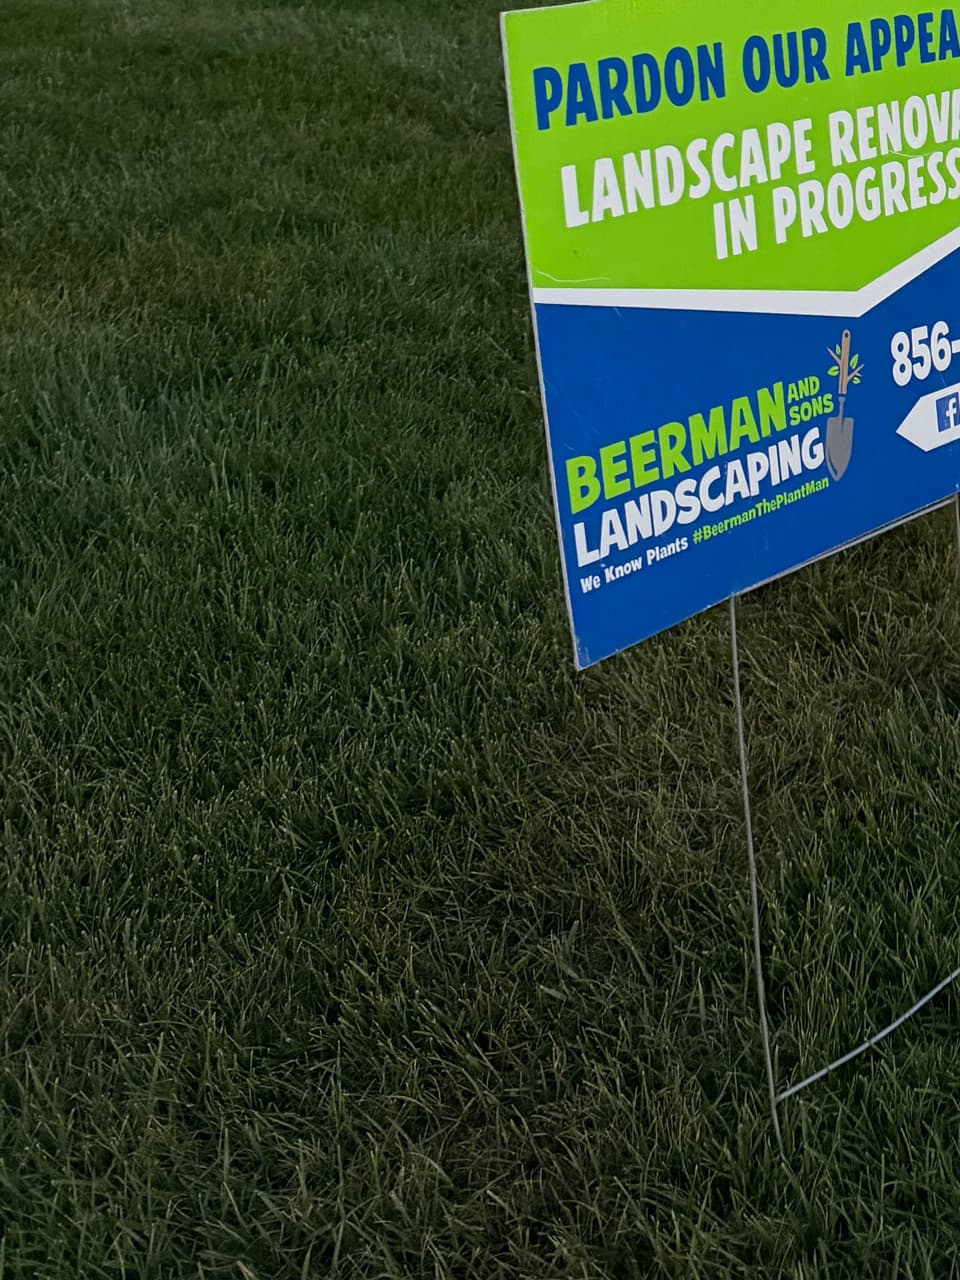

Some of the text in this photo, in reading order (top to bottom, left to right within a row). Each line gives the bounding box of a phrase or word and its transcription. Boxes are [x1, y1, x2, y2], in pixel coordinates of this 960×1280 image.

[533, 42, 726, 131] PARDON
[742, 27, 830, 93] OUR
[561, 118, 816, 228] LANDSCAPE
[713, 195, 758, 260] IN
[565, 376, 820, 515] BEERMAN AND
[789, 393, 835, 426] SONS
[573, 426, 825, 568] LANDSCAPING
[580, 477, 829, 594] We Know Plants #BeermanThePlantMan
